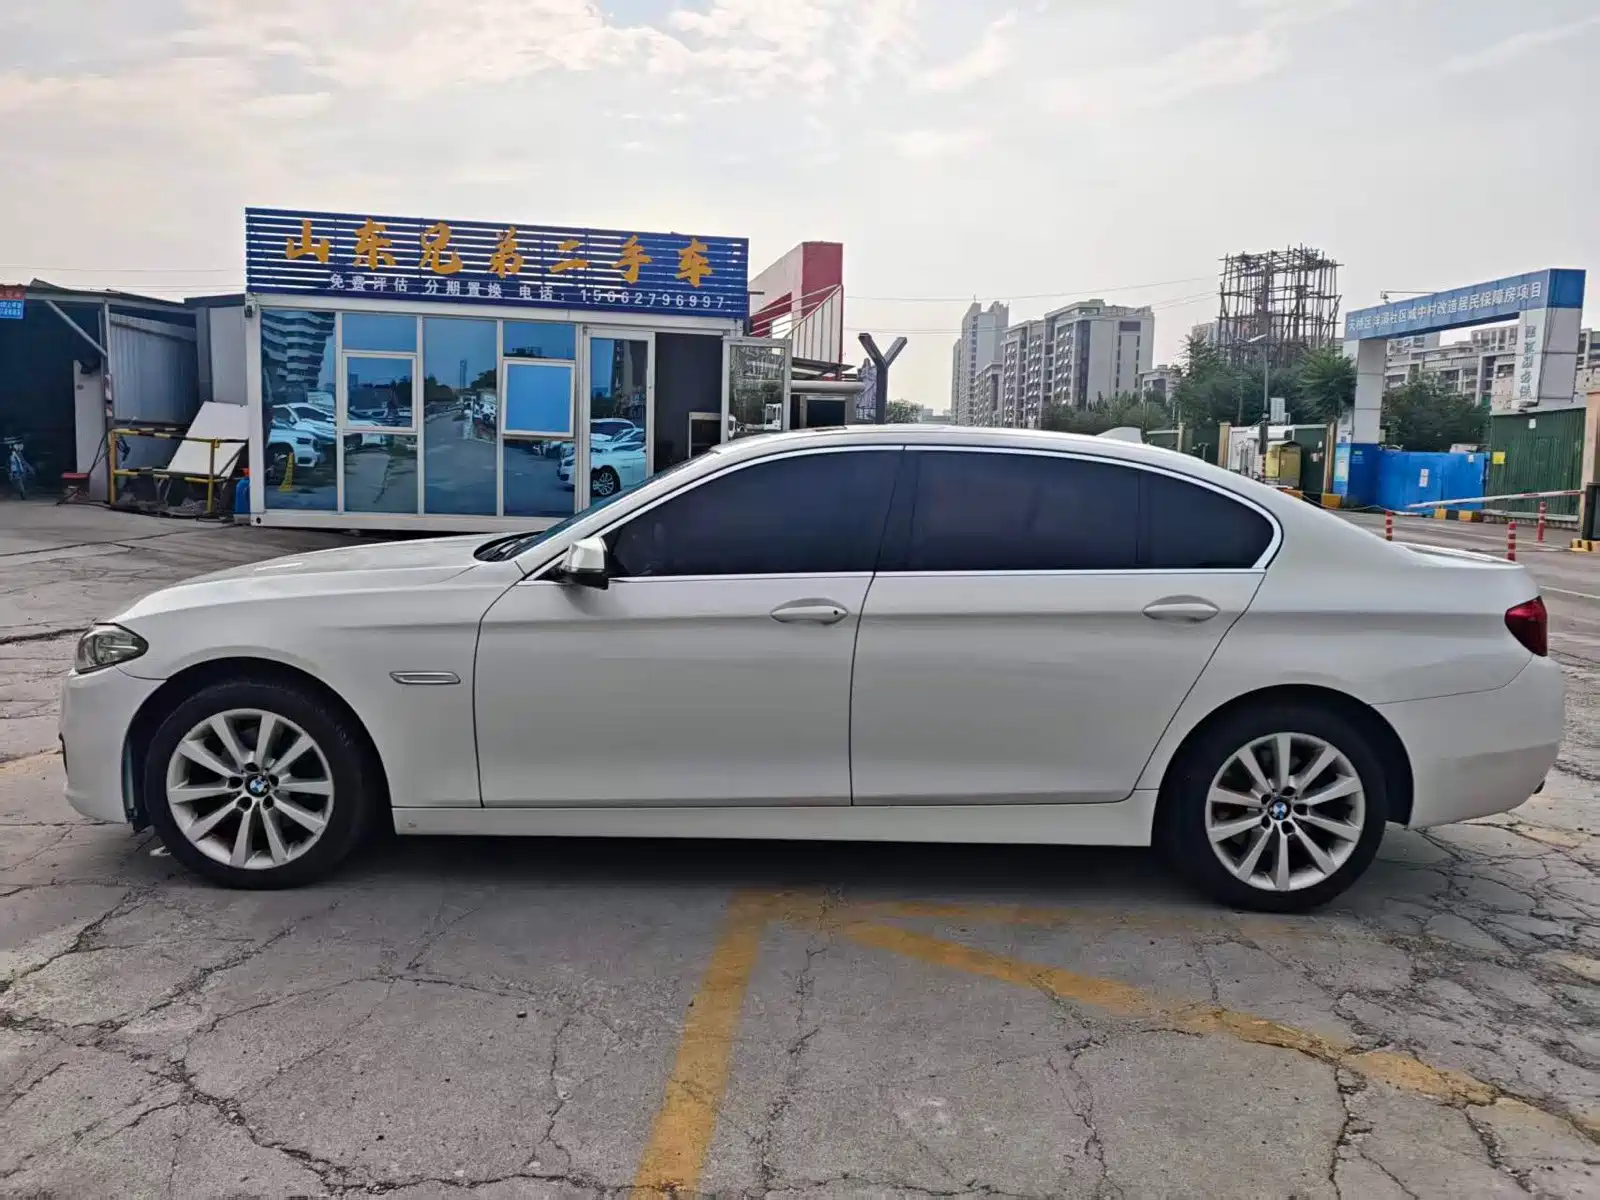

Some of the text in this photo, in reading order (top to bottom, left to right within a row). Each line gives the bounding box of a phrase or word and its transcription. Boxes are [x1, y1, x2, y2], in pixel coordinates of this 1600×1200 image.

[285, 217, 713, 287] 山东兄弟二手车
[327, 272, 409, 293] 免费评估
[424, 279, 502, 299] 分期置换
